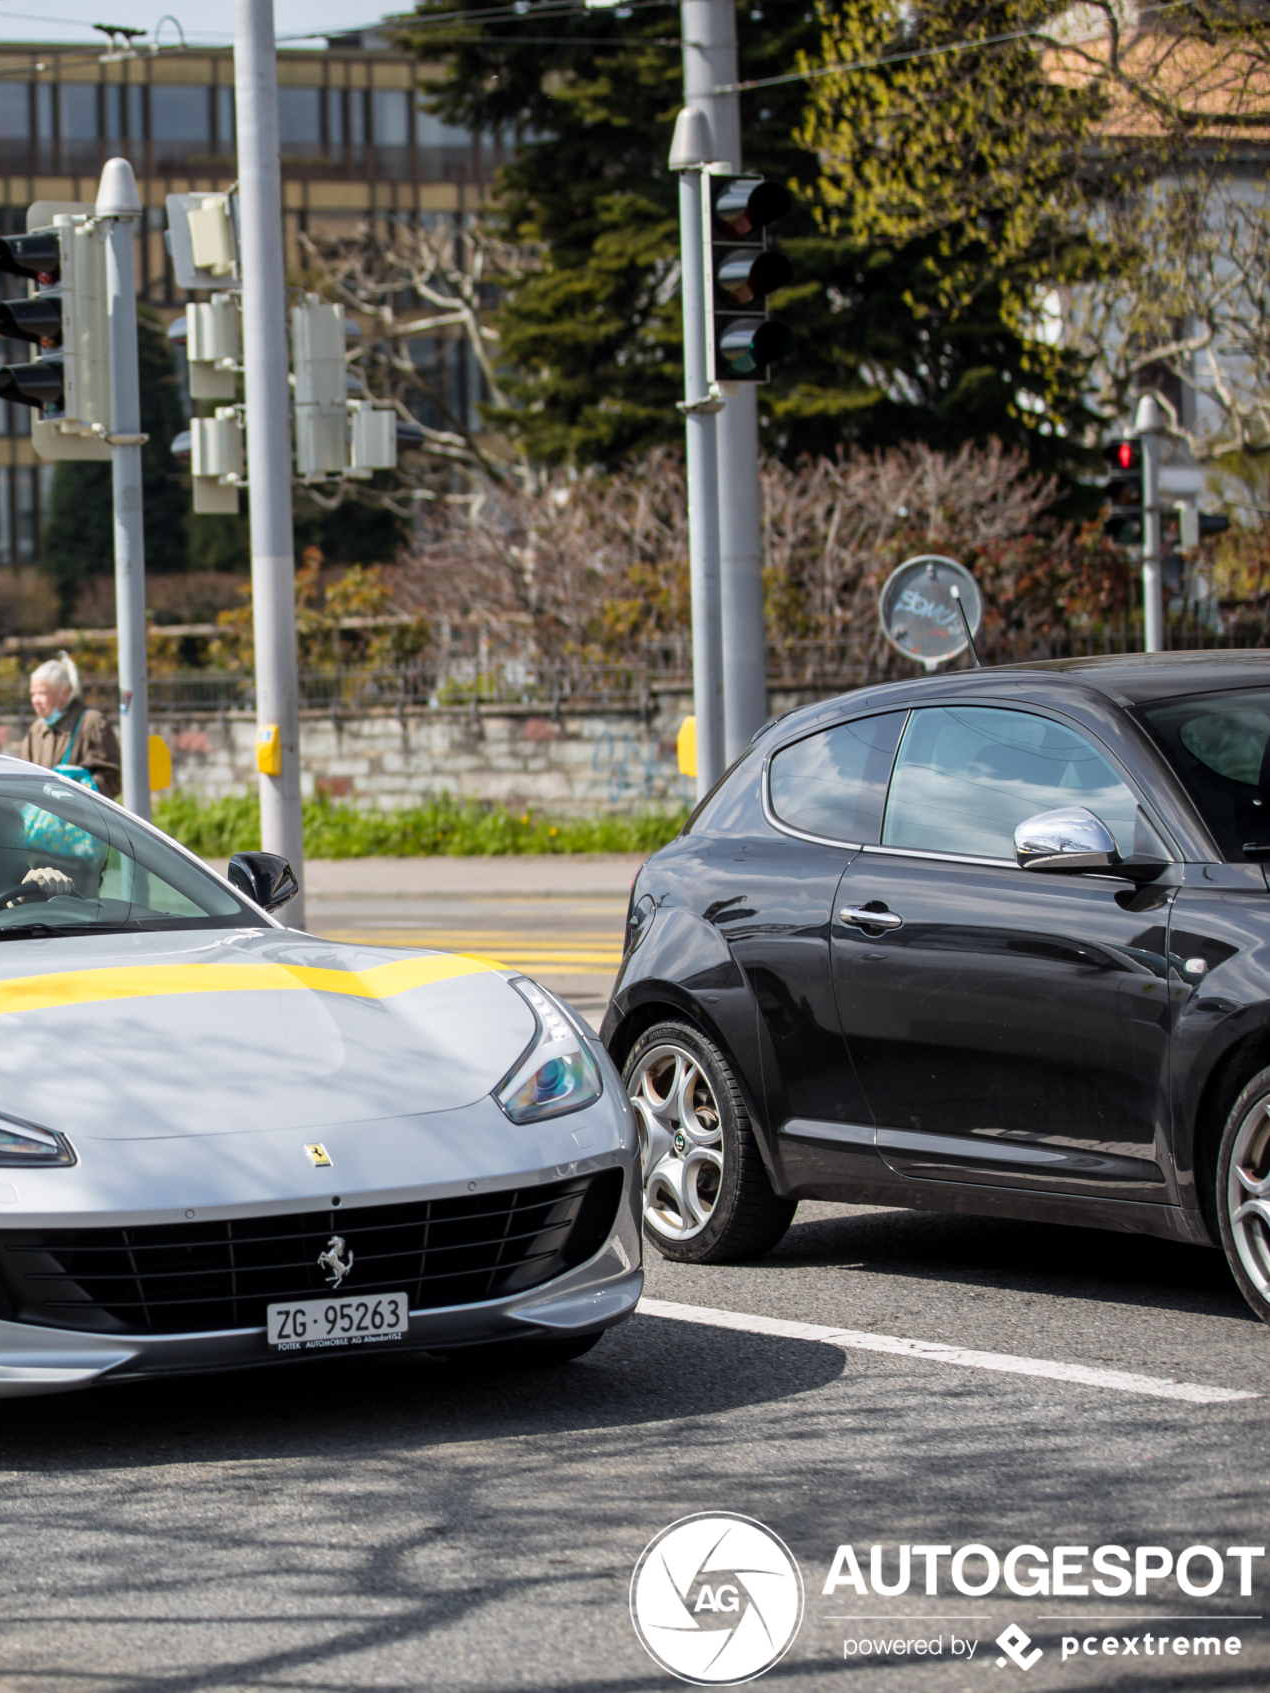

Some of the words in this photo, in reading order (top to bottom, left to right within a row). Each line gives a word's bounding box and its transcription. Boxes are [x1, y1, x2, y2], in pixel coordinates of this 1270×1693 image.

[278, 1342, 301, 1351] FOITEK
[306, 1338, 349, 1348] AUTOMOBILE
[351, 1336, 362, 1344] AG
